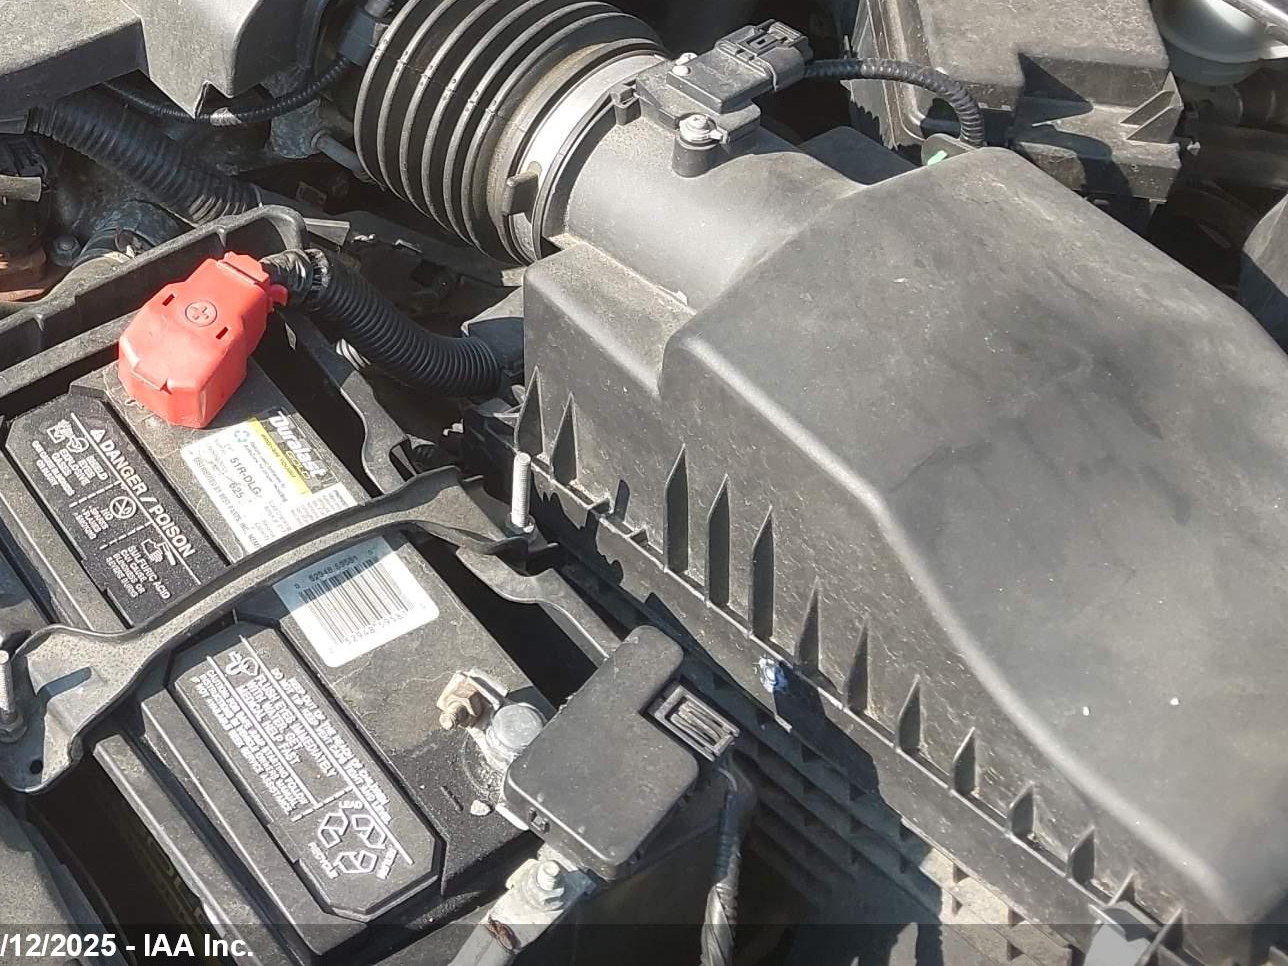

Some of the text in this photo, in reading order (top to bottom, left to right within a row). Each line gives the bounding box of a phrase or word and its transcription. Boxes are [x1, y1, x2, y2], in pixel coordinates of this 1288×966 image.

[50, 452, 72, 476] GASES
[268, 409, 327, 479] Duralast
[284, 449, 311, 480] GOLD
[58, 447, 90, 485] EXPLOSIVE
[77, 458, 96, 479] EYES
[84, 454, 109, 480] SHIELD
[229, 456, 262, 495] 51R-DLG
[99, 439, 148, 496] DANGER
[148, 503, 195, 558] POISON
[227, 481, 245, 499] 625
[100, 507, 114, 520] NO
[104, 556, 138, 598] SEVERE BURNS
[112, 552, 145, 593] BLINDNESS OR
[119, 549, 147, 582] CAN CAUSE
[126, 545, 171, 599] SULFURIC ACID
[194, 682, 209, 698] NOT
[204, 697, 232, 731] AVAILABLE
[239, 746, 264, 774] SERVICE
[198, 674, 234, 719] INSTRUCTIONS
[236, 727, 258, 752] VEHICLE
[235, 683, 301, 767] MEDICAL HELP FAST
[245, 679, 267, 702] WITH
[283, 731, 303, 751] GET
[254, 672, 338, 780] FLUSH EYES IMMEDIATELY
[225, 697, 241, 712] FOR
[235, 711, 253, 729] SAFE
[260, 745, 289, 778] STARTING
[283, 776, 309, 805] FOLLOW
[270, 667, 284, 679] DO
[278, 678, 295, 694] NOT
[301, 708, 319, 727] KEEP
[314, 726, 332, 745] VENT
[327, 743, 348, 764] CAPS
[359, 784, 376, 802] AND
[288, 677, 389, 805] KEEP OUT OF THE REACH OF CHILDREN
[339, 801, 363, 809] LEAD
[306, 841, 339, 879] RECYCLE
